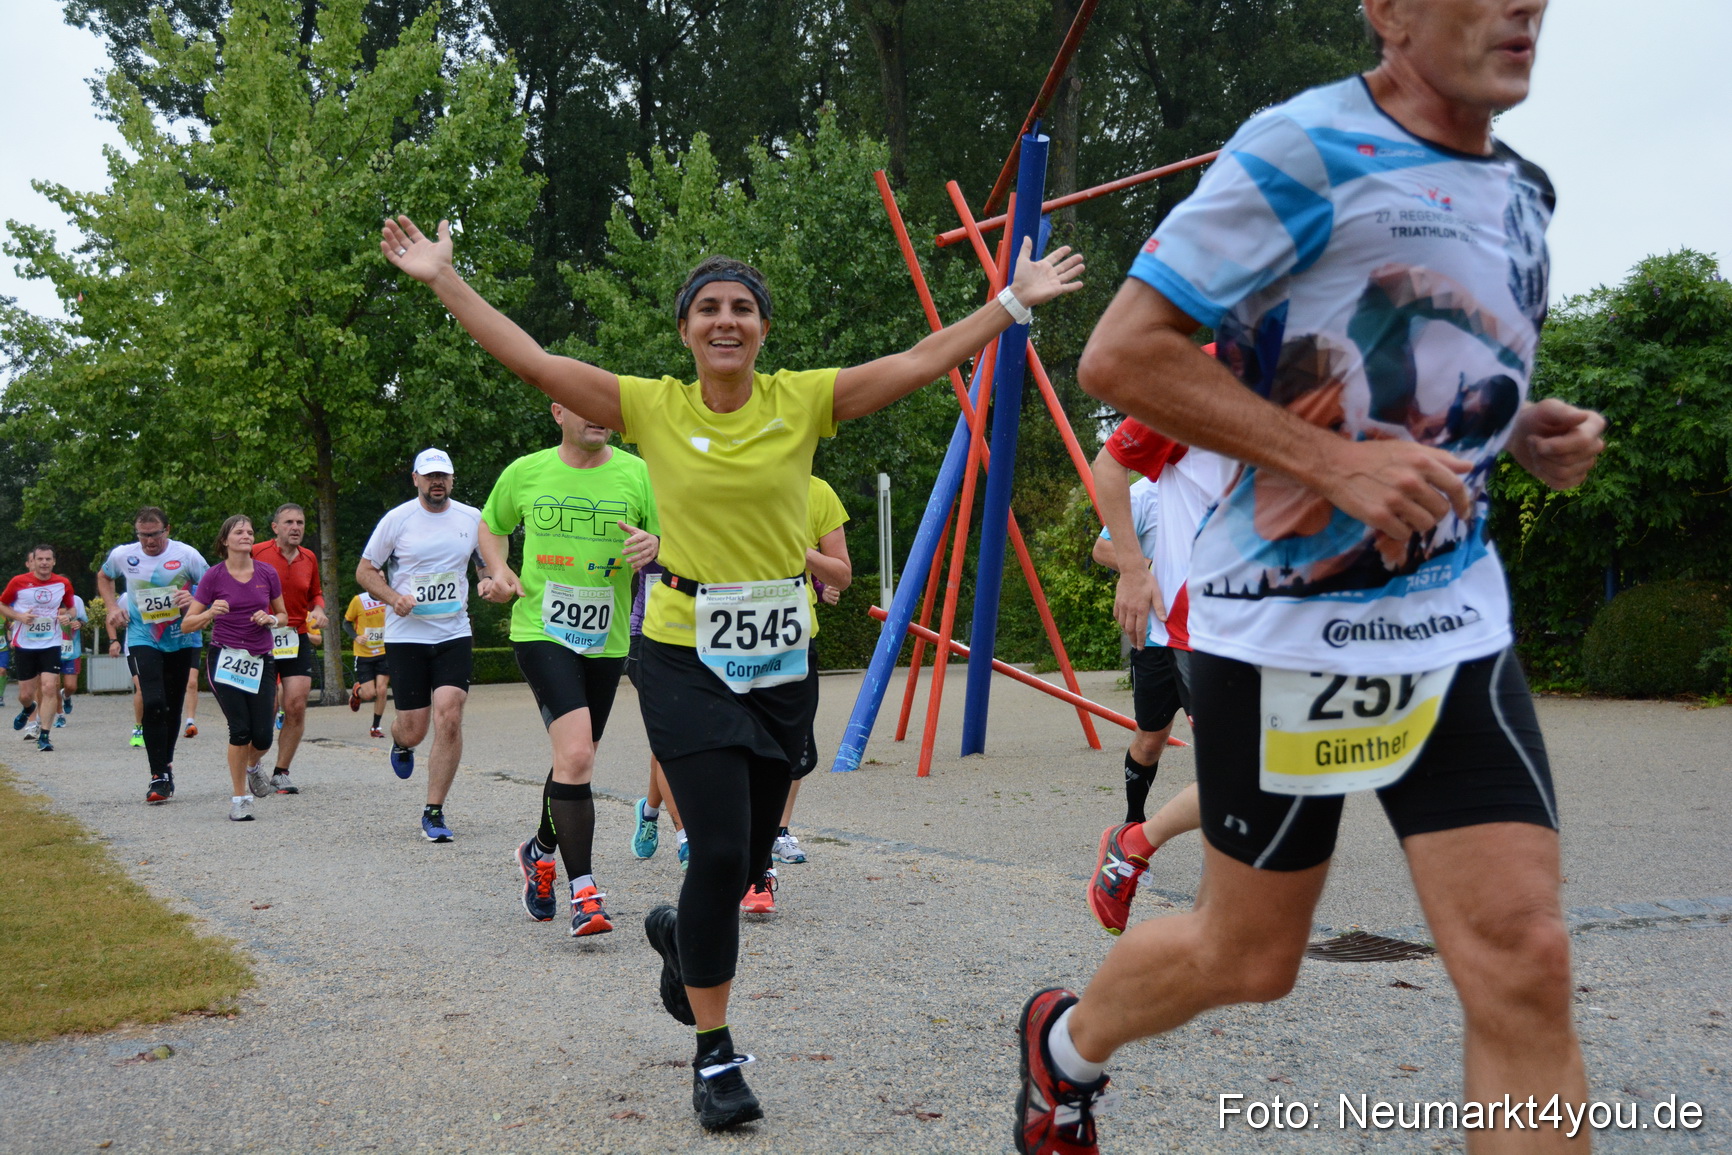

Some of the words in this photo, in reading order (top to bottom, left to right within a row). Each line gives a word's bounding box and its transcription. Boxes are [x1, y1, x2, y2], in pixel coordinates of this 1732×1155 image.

[1390, 226, 1458, 239] TRIATHLON
[537, 554, 575, 567] MERZ
[416, 582, 457, 603] 3022
[579, 589, 612, 599] BOCK
[752, 584, 798, 599] BOCK
[145, 595, 172, 612] 254
[550, 600, 610, 630] 2920
[28, 622, 51, 632] 2455
[710, 606, 803, 651] 2545
[274, 634, 290, 647] 61
[369, 632, 383, 641] 294
[565, 632, 593, 647] Klaus
[222, 655, 260, 678] 2435
[726, 659, 782, 678] Cornelia
[230, 674, 245, 685] Petra
[1315, 731, 1409, 766] Günther
